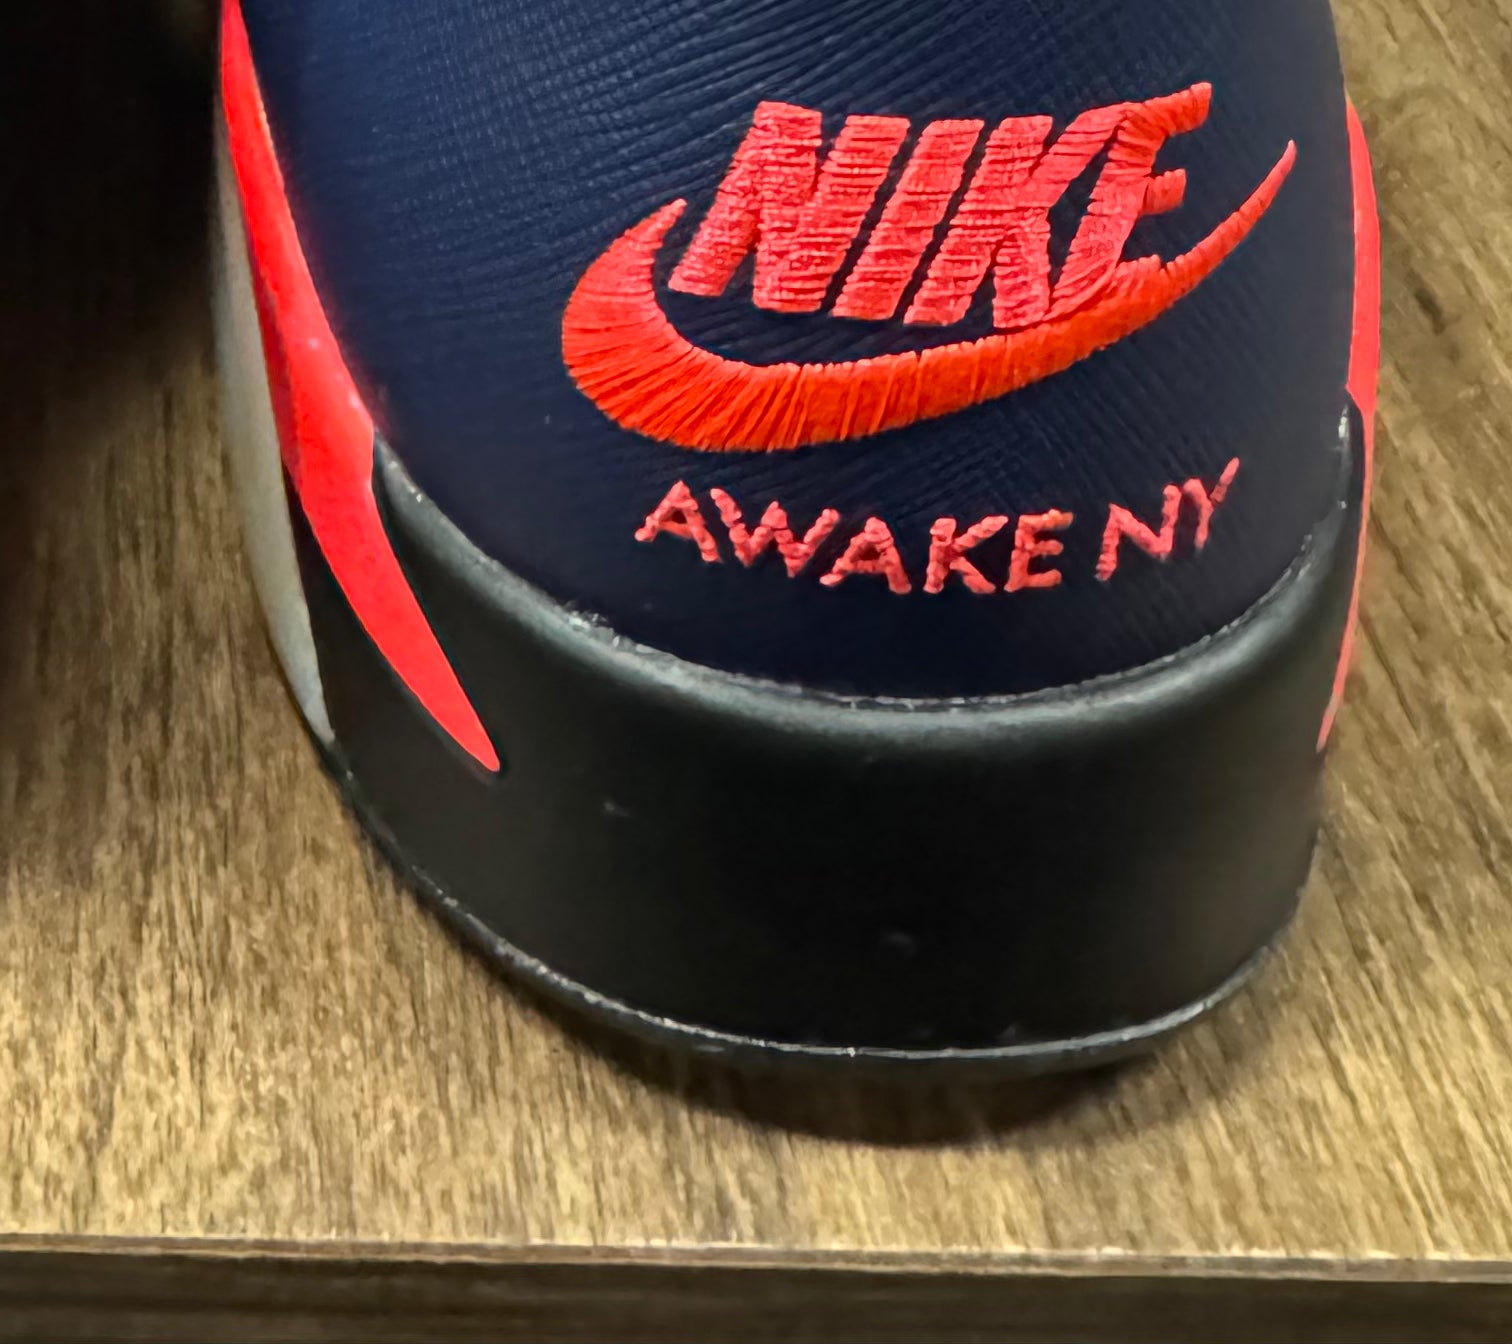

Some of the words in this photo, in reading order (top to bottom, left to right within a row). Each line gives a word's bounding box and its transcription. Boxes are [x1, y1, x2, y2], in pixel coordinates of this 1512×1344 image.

[668, 81, 1213, 329] NIKE
[635, 479, 1075, 594] AWAKE
[1097, 457, 1240, 581] NY
